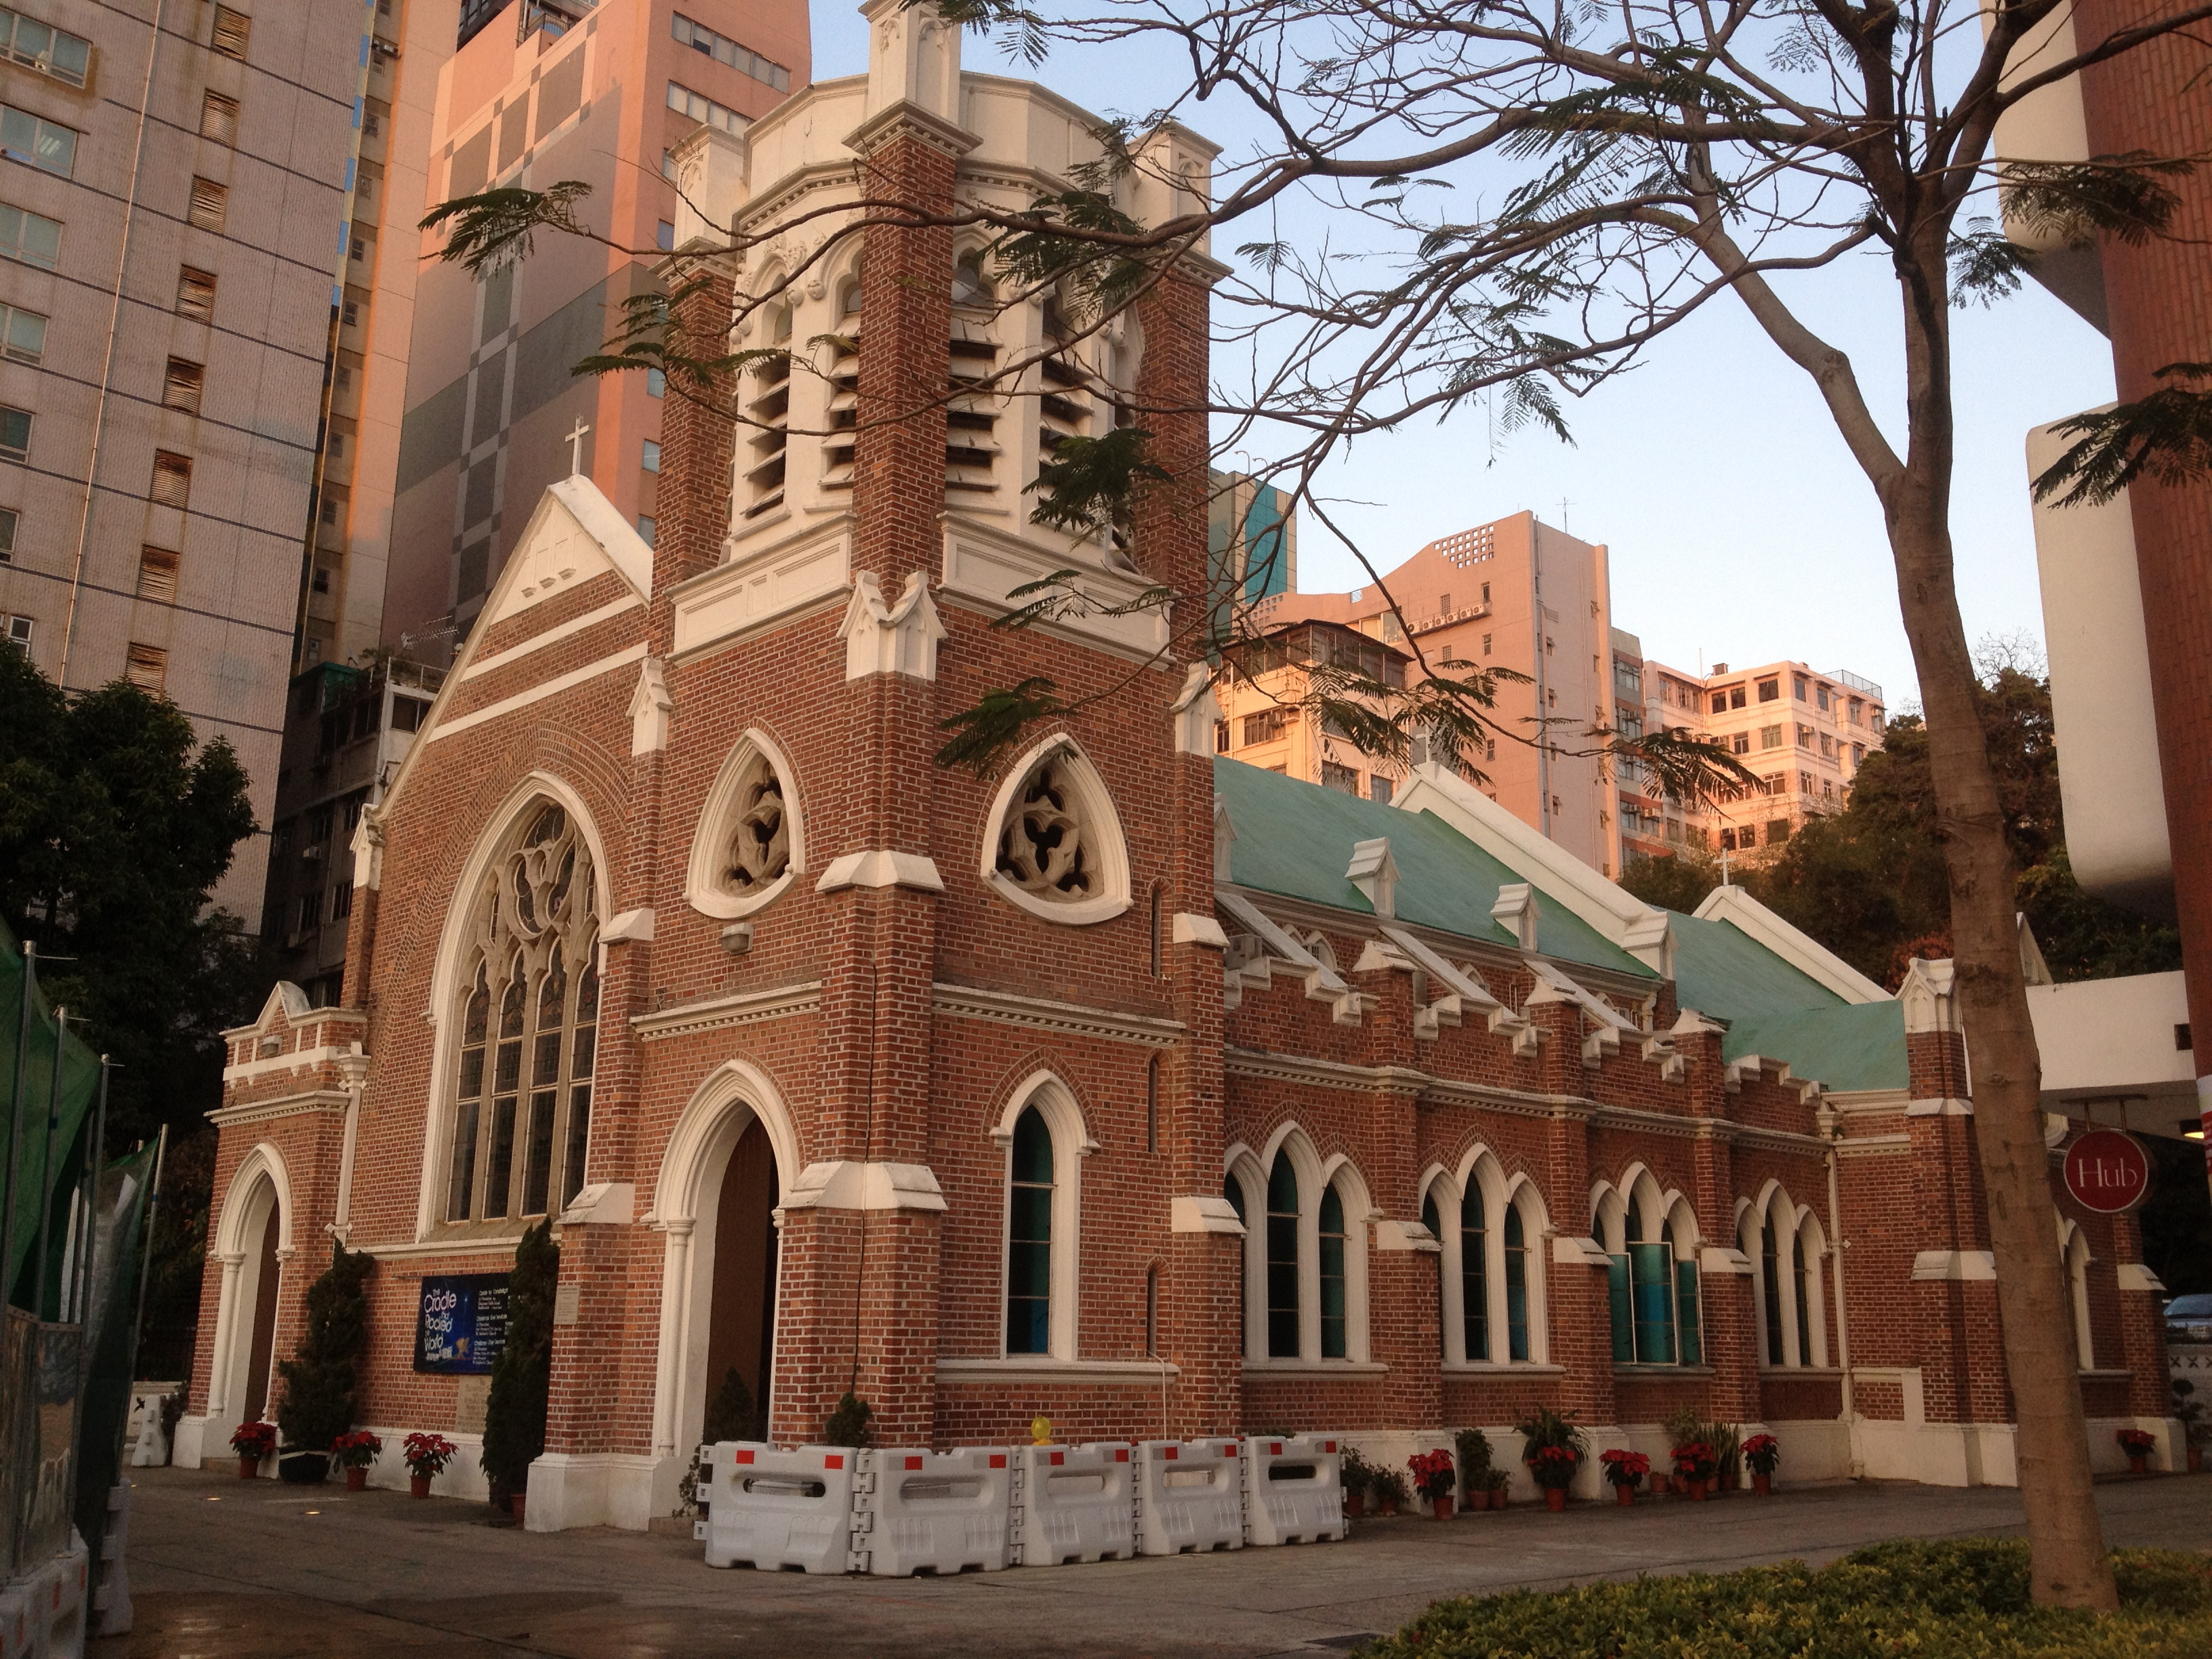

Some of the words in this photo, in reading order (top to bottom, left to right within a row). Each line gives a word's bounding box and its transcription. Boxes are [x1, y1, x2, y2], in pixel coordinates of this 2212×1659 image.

[2077, 1158, 2137, 1187] Hub
[424, 1290, 457, 1313] Cradle
[424, 1332, 443, 1351] World
